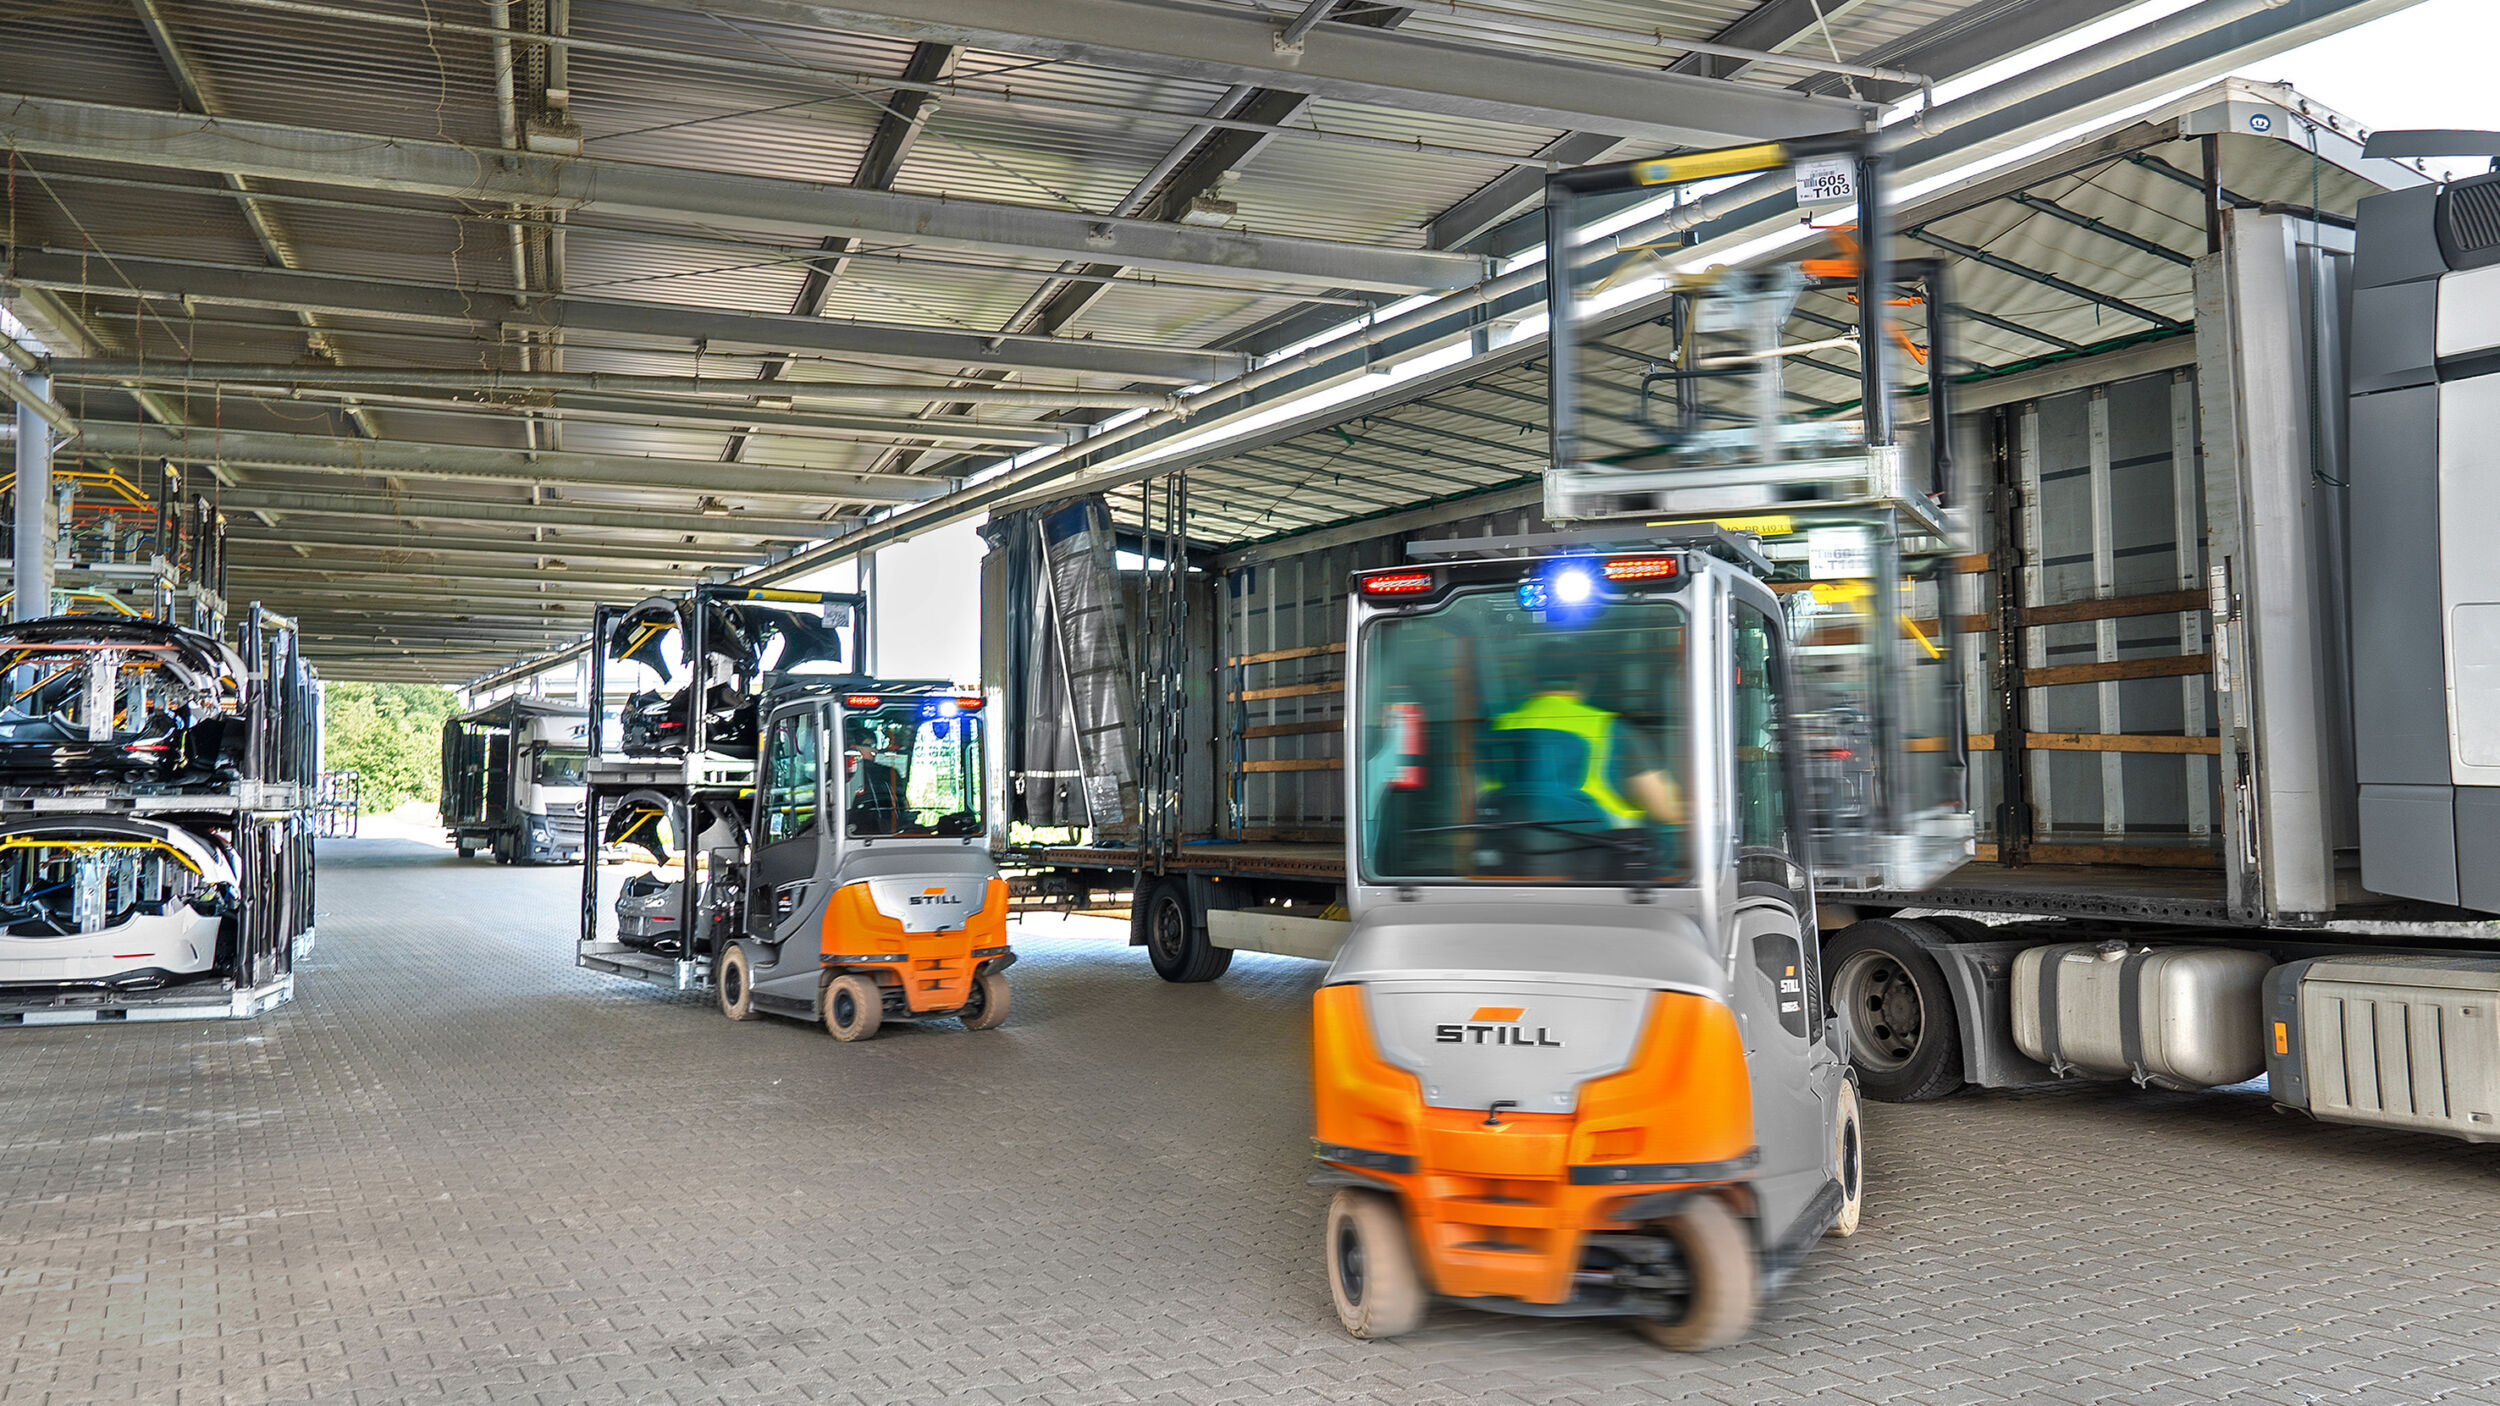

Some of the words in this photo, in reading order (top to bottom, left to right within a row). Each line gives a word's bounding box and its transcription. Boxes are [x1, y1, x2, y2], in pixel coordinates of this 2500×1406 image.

[1818, 174, 1845, 187] 605
[1813, 184, 1850, 198] T103
[908, 895, 962, 905] STILL
[1780, 978, 1801, 994] STILL
[1436, 1024, 1561, 1047] STILL
